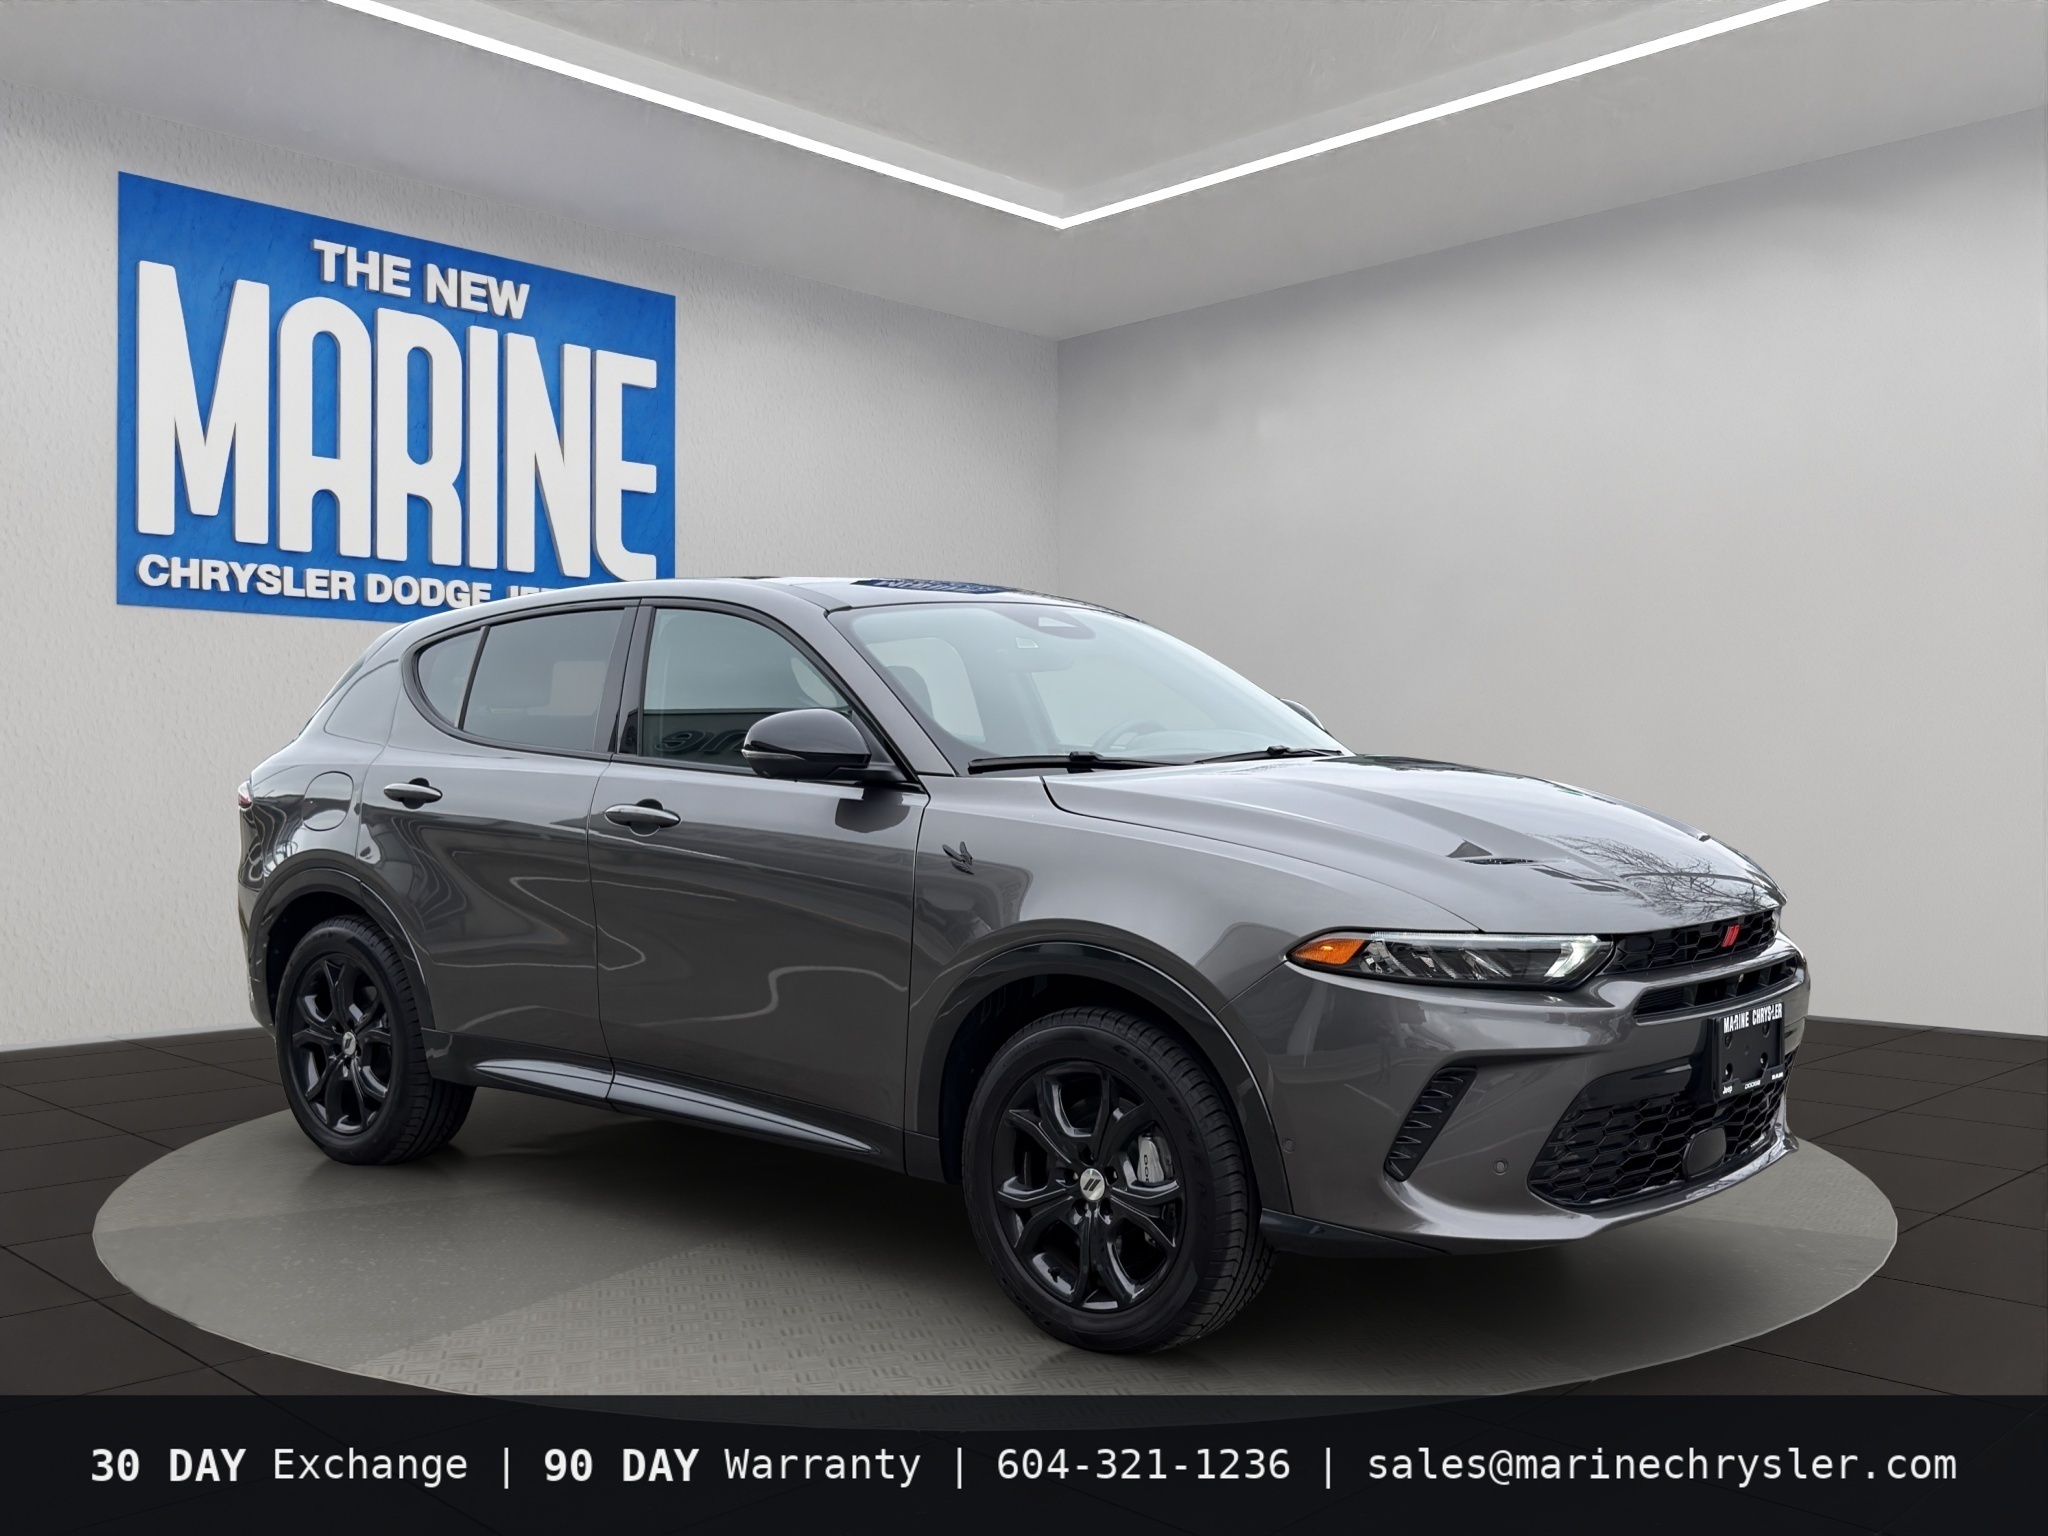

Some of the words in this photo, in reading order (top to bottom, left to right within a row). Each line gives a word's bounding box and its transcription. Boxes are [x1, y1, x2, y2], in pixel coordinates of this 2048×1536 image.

[311, 239, 411, 298] THE
[423, 263, 530, 320] NEW
[136, 260, 657, 581] MARINE
[137, 554, 356, 601] CHRYSLER
[365, 573, 493, 609] DODGE
[1723, 1011, 1750, 1034] MARINE
[1752, 1003, 1783, 1025] CHRYSLER
